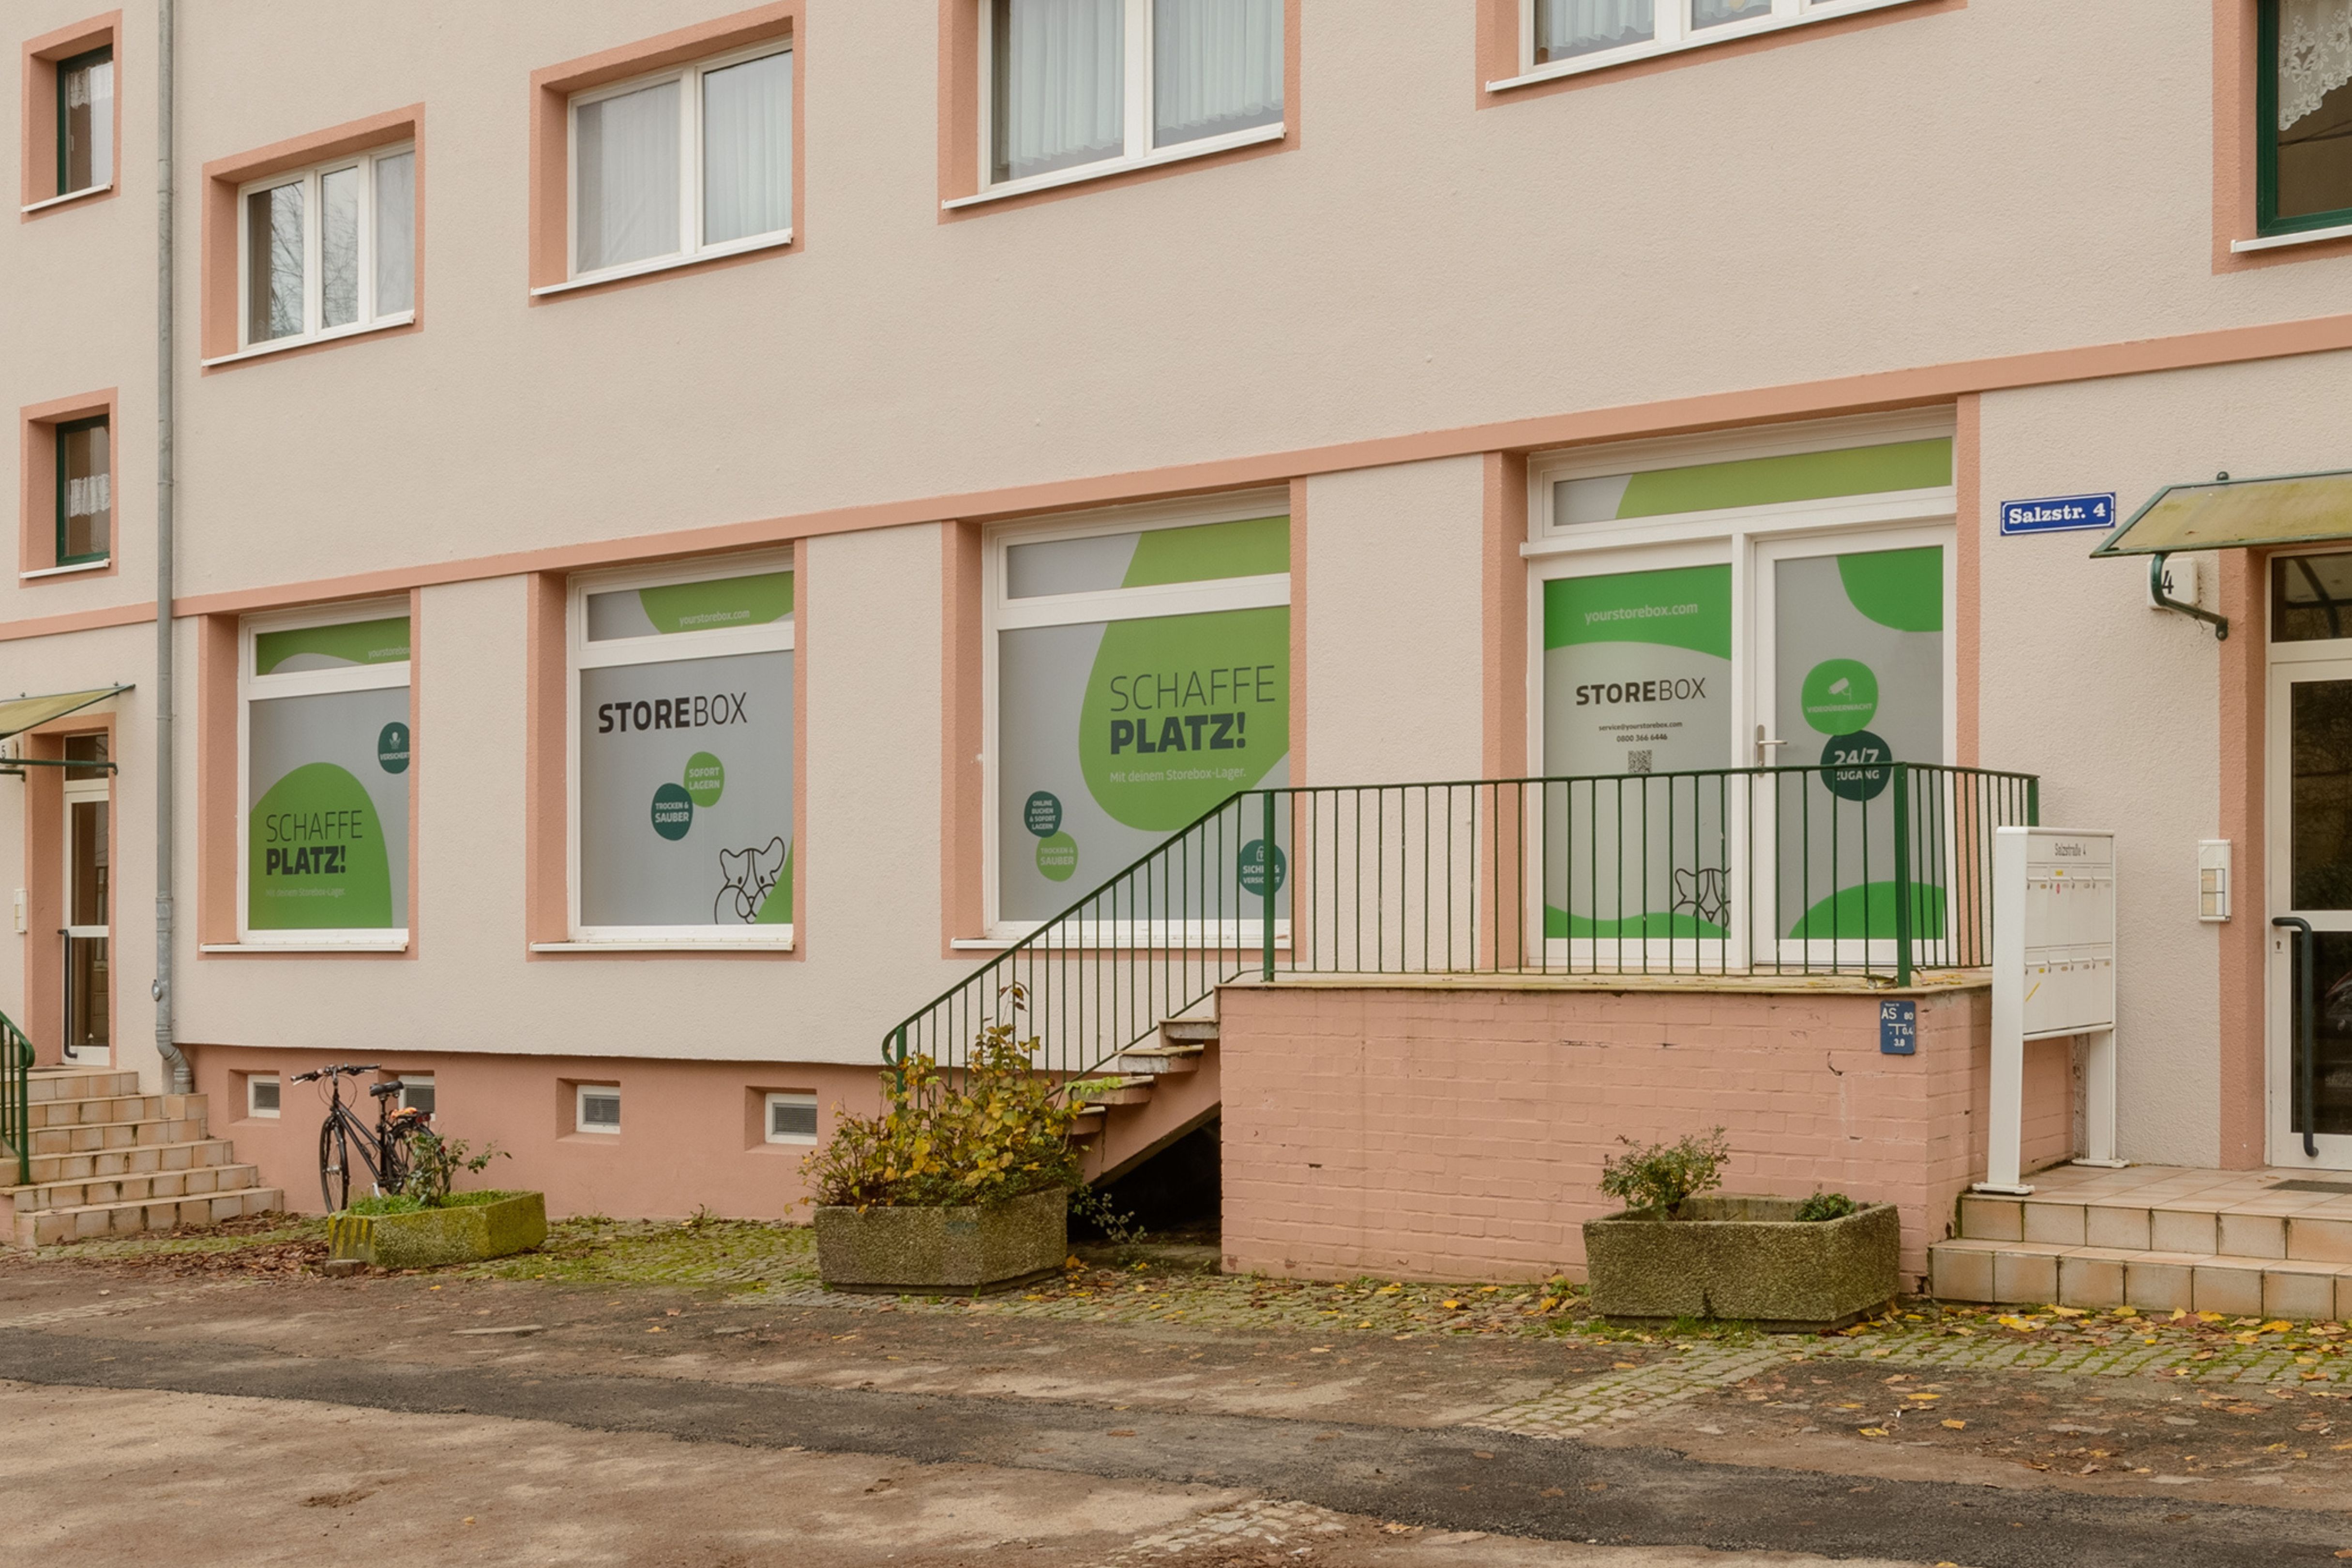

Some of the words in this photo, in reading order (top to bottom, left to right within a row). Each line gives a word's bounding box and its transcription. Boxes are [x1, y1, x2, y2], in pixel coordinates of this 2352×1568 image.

[2009, 505, 2086, 525] Salzstr.
[2093, 502, 2106, 517] 4
[2161, 570, 2174, 594] 4
[679, 610, 750, 627] yourstorebox.com
[1584, 604, 1698, 626] yourstorebox.com
[1110, 665, 1275, 712] SCHAFFE
[1576, 678, 1706, 706] STOREBOX
[598, 692, 747, 734] STOREBOX
[1111, 712, 1246, 755] PLATZ!
[1598, 722, 1683, 731] service@yourstorebox.com
[1834, 748, 1879, 765] 24/7
[689, 767, 720, 777] SOFORT
[1110, 772, 1126, 783] Mit
[1128, 770, 1163, 782] deinem
[1166, 768, 1246, 781] Storebox-Lager.
[689, 780, 720, 790] LAGERN
[266, 810, 362, 842] SCHAFFE
[655, 812, 689, 823] SAUBER
[267, 845, 346, 875] PLATZ!
[1040, 856, 1074, 865] SAUBER
[1881, 1008, 1897, 1020] AS
